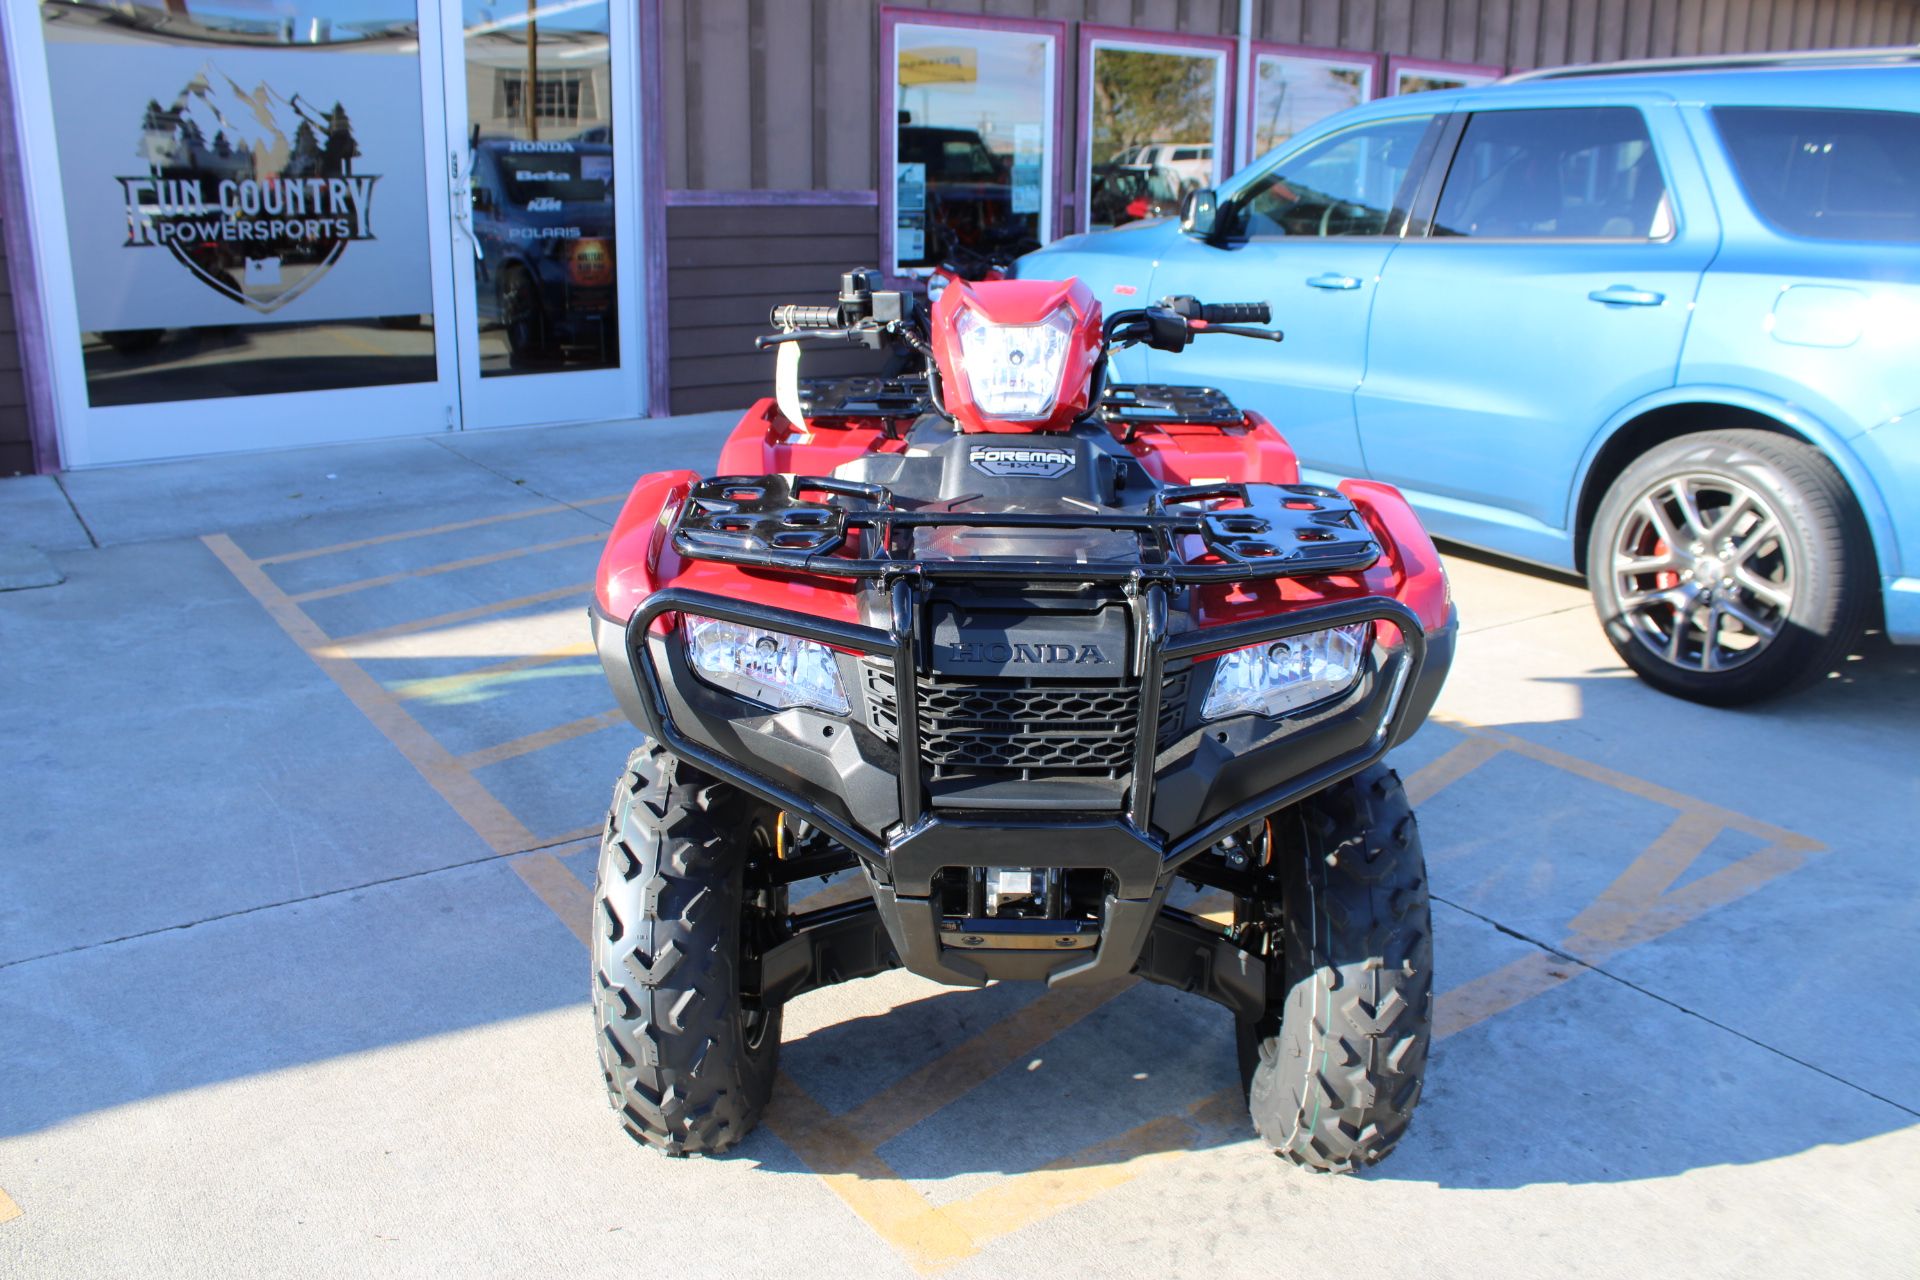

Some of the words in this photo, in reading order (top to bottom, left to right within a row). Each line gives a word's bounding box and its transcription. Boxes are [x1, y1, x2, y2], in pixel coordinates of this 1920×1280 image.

[509, 141, 575, 152] HONDA
[515, 170, 571, 182] Beta
[126, 179, 200, 244] FUN
[218, 178, 372, 238] COUNTRY
[527, 197, 562, 212] KTM
[160, 218, 350, 242] POWERSPORTS
[509, 227, 581, 240] POLARIS
[969, 451, 1076, 465] FOREMAN
[949, 642, 1110, 664] HONDA
